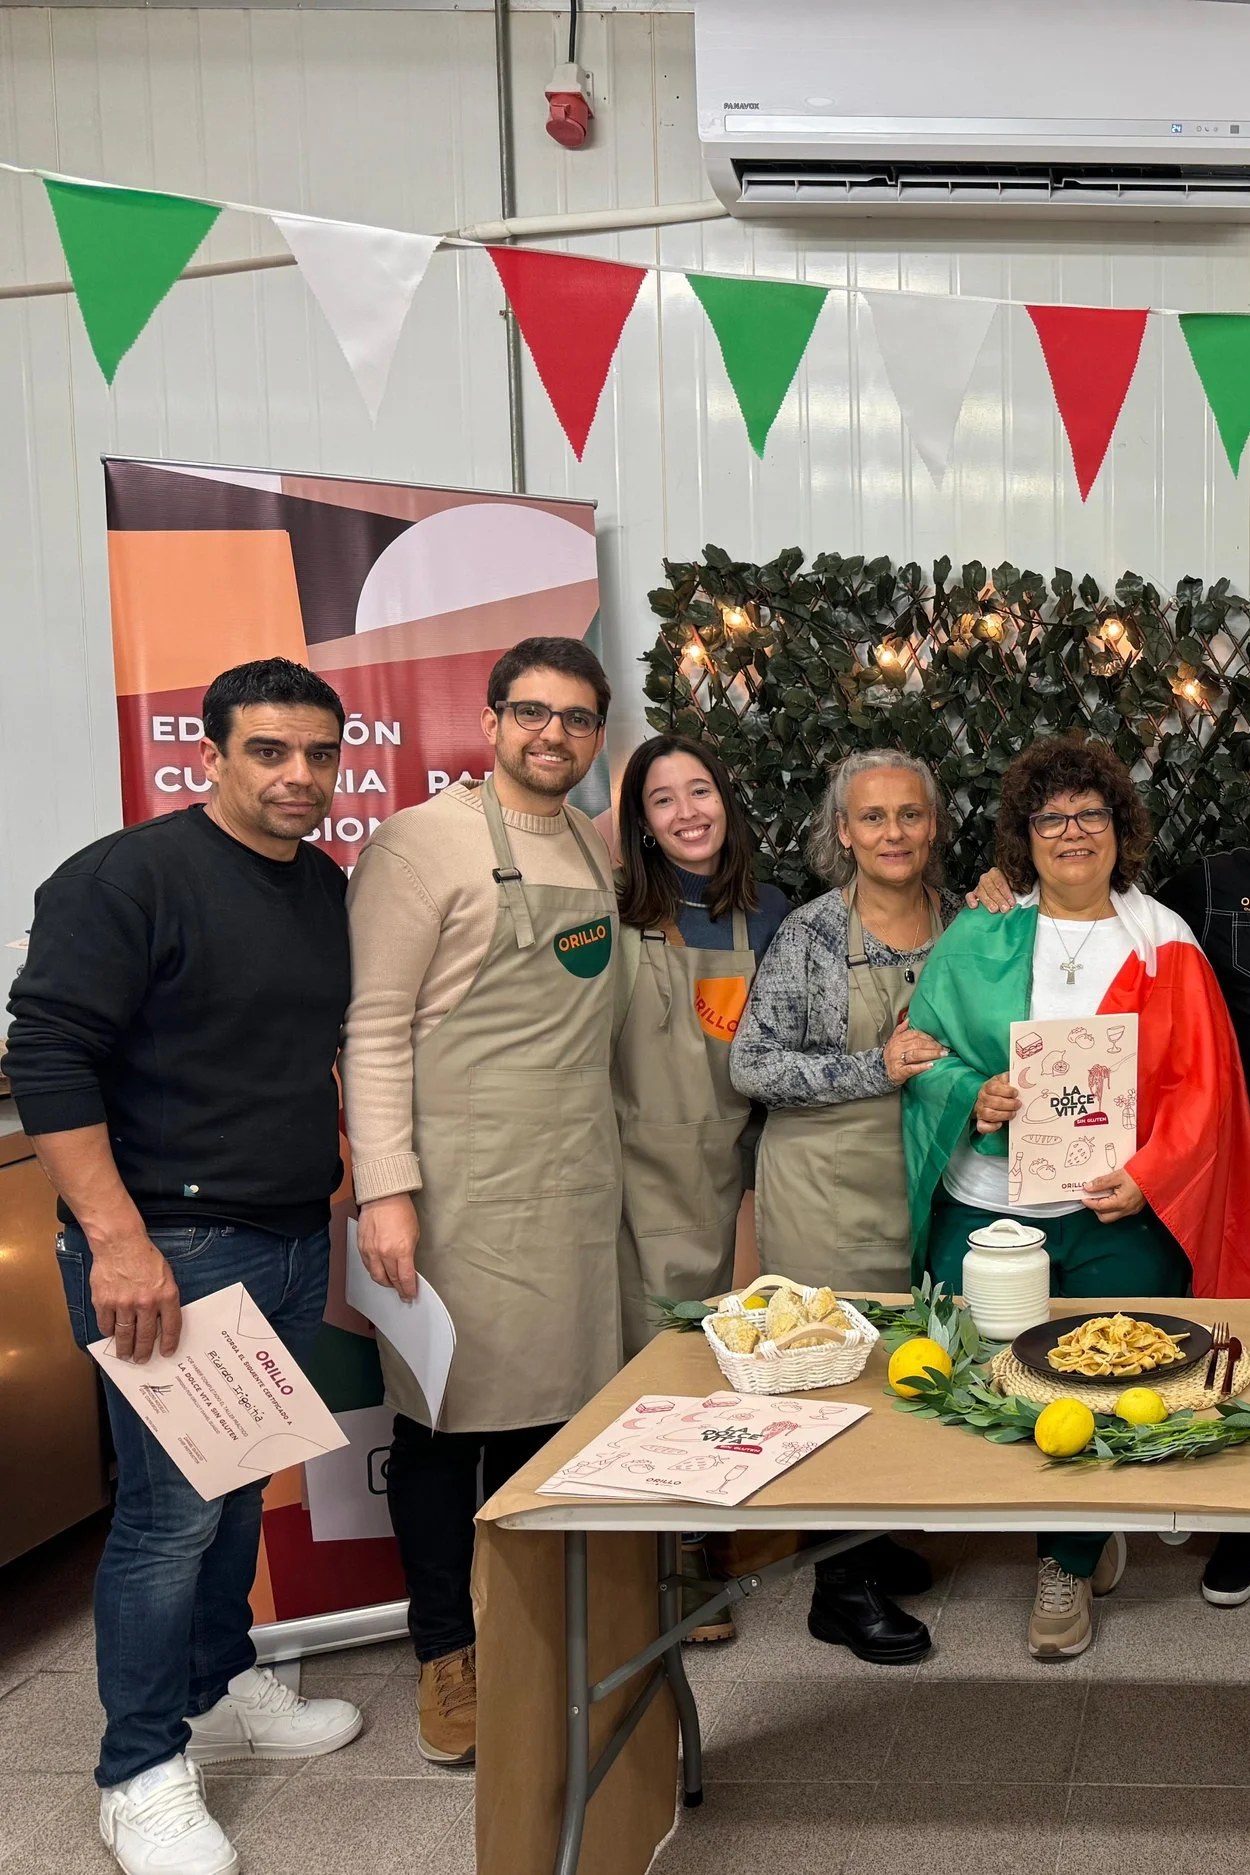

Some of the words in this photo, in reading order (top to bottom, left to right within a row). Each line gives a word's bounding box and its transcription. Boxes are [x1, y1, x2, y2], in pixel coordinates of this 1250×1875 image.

[559, 925, 606, 951] ORILLO
[696, 987, 739, 1033] RILLO
[1050, 1094, 1094, 1107] DOLCE
[1063, 1085, 1080, 1096] LA
[1055, 1105, 1088, 1117] VITA
[207, 1350, 233, 1382] Ricardo
[221, 1330, 239, 1353] OTORGA
[237, 1353, 245, 1361] EL
[243, 1361, 265, 1387] SIGUIENTE
[262, 1387, 289, 1419] CERTIFICADO
[255, 1350, 293, 1395] ORILLO
[177, 1362, 186, 1372] LA
[184, 1372, 202, 1392] DOLCE
[199, 1391, 212, 1407] VITA
[210, 1407, 221, 1418] SIN
[219, 1418, 238, 1440] GLUTEN
[701, 1430, 763, 1440] DOLCE
